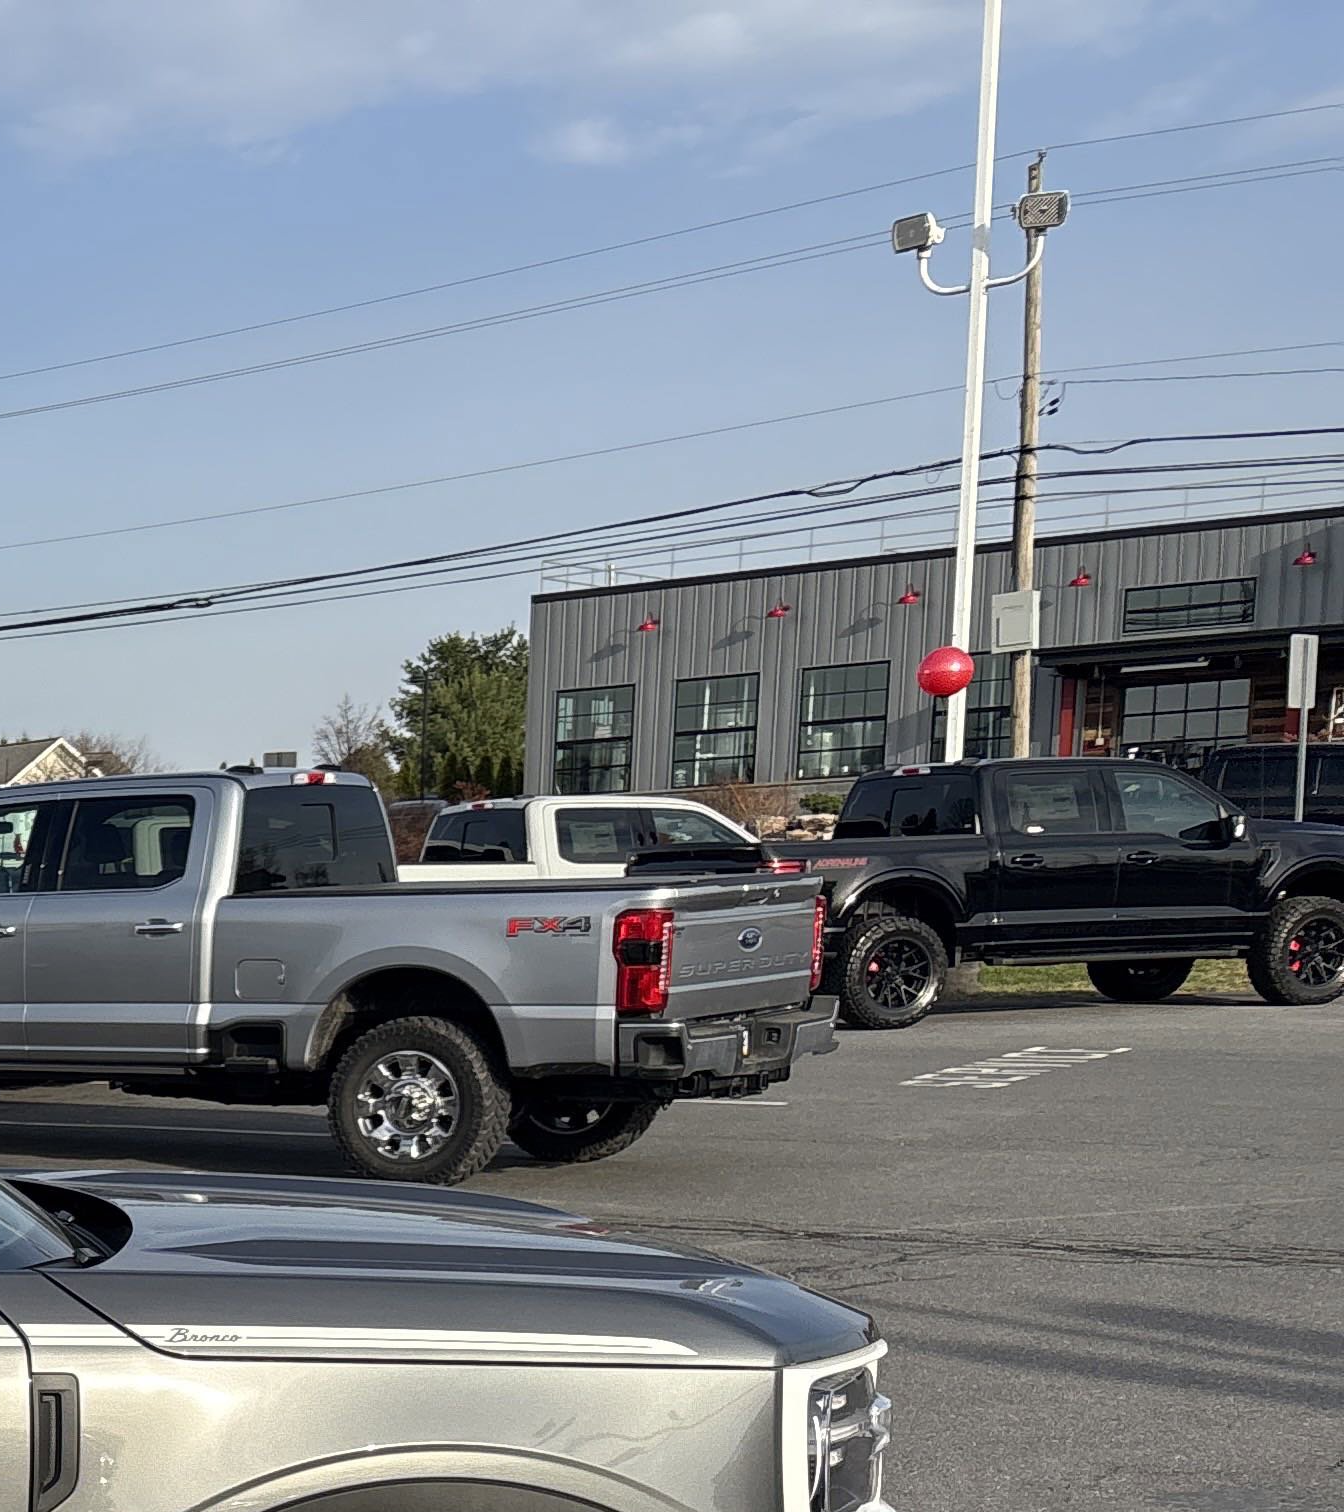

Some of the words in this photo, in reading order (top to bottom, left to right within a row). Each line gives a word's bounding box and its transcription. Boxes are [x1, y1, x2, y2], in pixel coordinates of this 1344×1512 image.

[506, 916, 591, 937] FX4
[679, 959, 755, 978] SUPER
[759, 951, 809, 969] DUTY
[165, 1327, 242, 1343] Bronco
